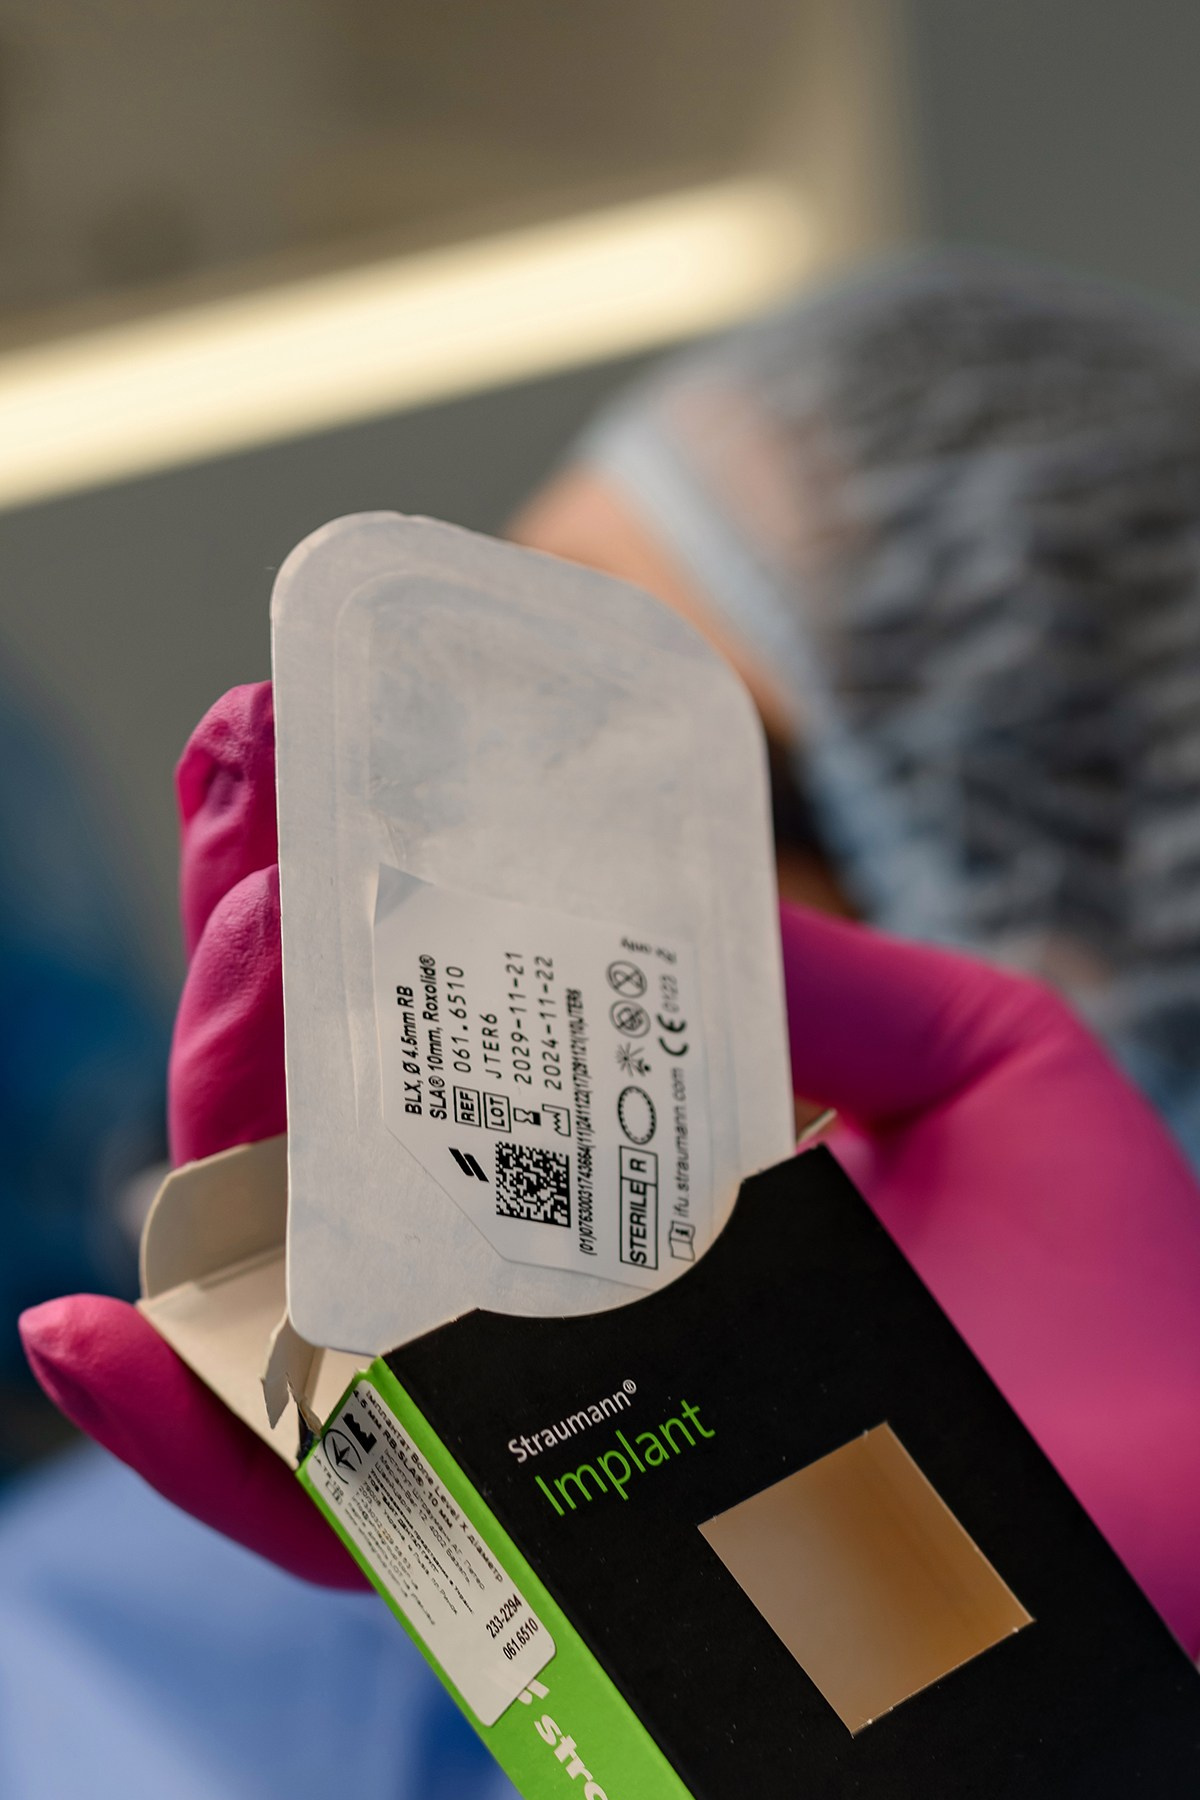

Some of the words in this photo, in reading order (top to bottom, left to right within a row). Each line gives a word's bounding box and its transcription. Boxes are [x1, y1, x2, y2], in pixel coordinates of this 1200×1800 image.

[396, 985, 414, 1008] RB
[419, 954, 440, 1022] Roxolid®
[400, 1012, 418, 1058] 4.5mm
[446, 966, 471, 1073] 061.6510
[480, 1013, 502, 1079] JTER6
[505, 952, 532, 1085] 2029-11-21
[534, 956, 562, 1091] 2024-11-22
[427, 1027, 444, 1071] 10mm,
[404, 1079, 423, 1115] BLX,
[429, 1075, 447, 1120] SLA®
[459, 1091, 475, 1122] REF
[489, 1097, 505, 1127] LOT
[629, 1158, 647, 1173] R
[671, 1066, 690, 1218] ifu.straumann.com
[629, 1180, 647, 1265] STERILE
[507, 1378, 637, 1465] Straumann®
[534, 1399, 716, 1518] Implant
[410, 1451, 434, 1486] Bone
[434, 1484, 460, 1521] Level
[459, 1520, 468, 1533] X
[467, 1532, 503, 1583] діаметр
[485, 1592, 522, 1640] 233-2294
[502, 1616, 539, 1662] 061.6510
